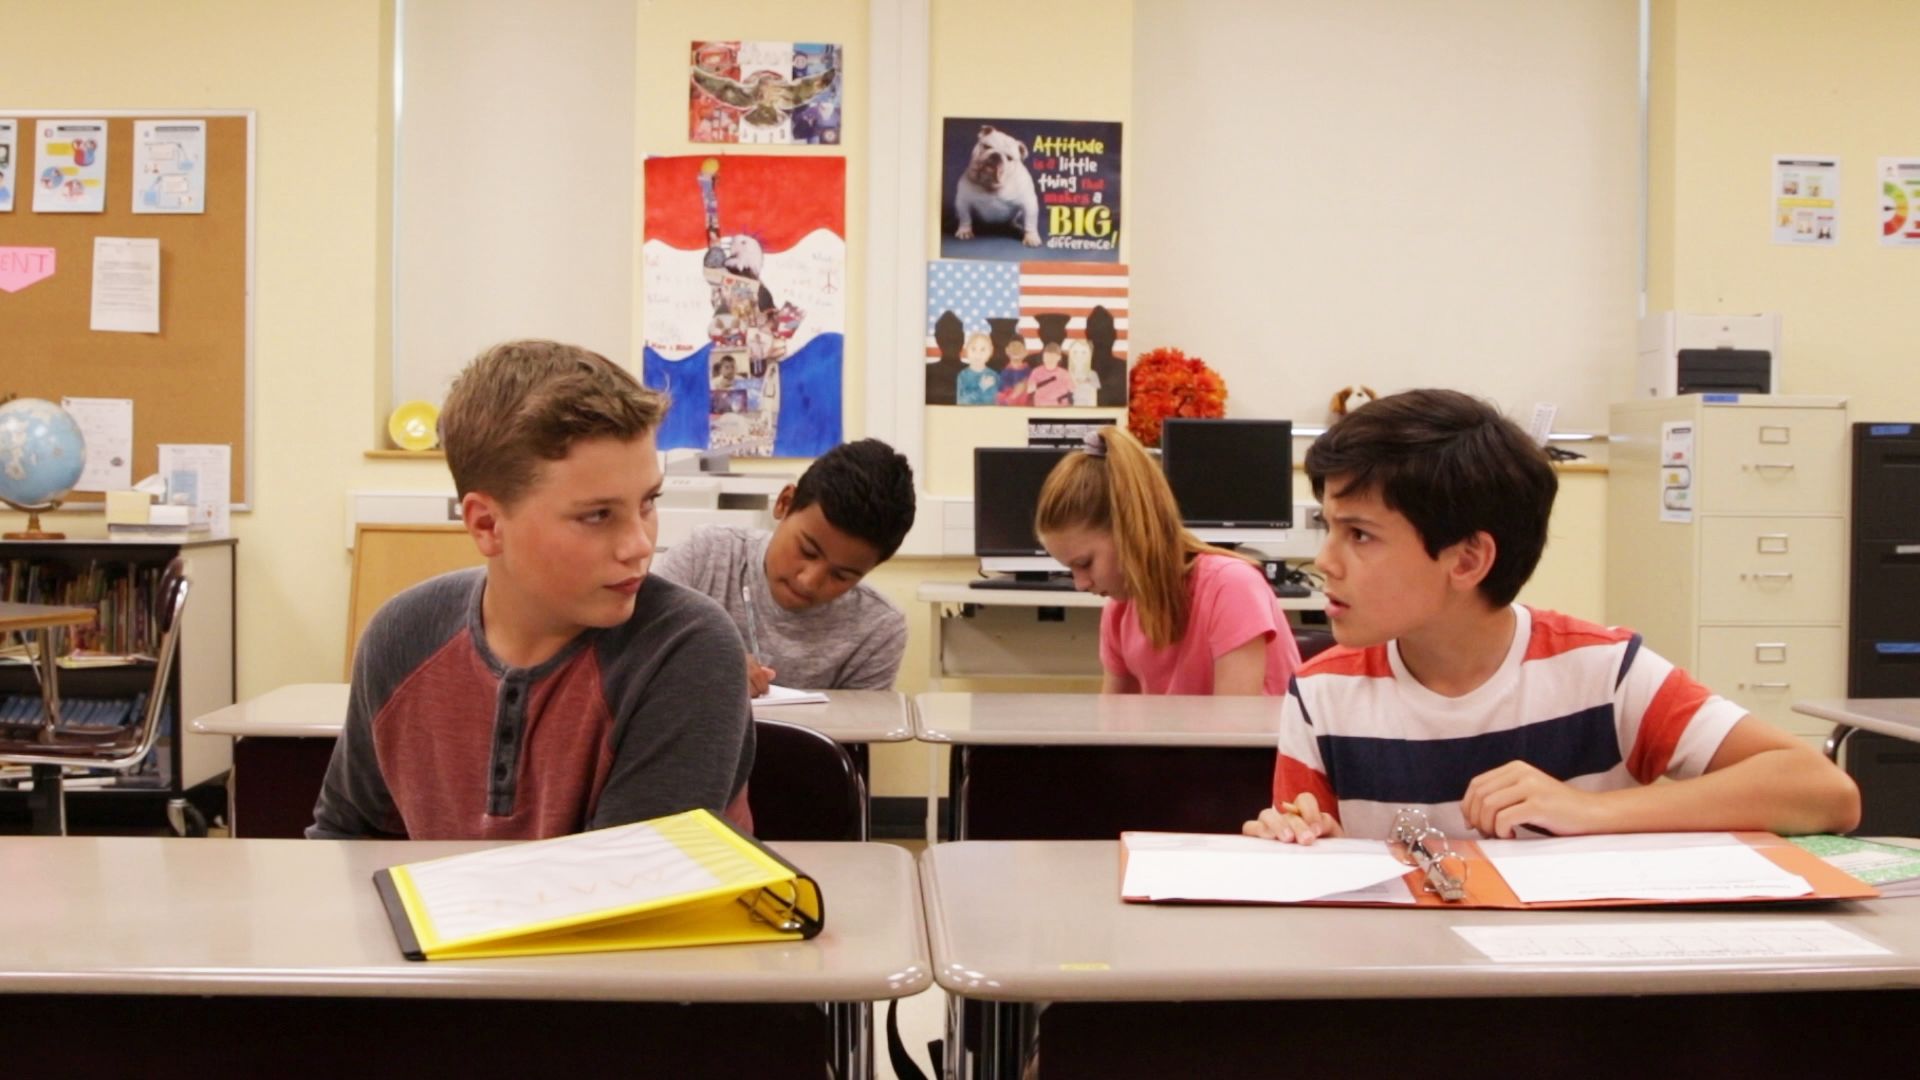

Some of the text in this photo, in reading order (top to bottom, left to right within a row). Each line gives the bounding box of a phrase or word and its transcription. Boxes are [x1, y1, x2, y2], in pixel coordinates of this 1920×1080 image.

[1033, 135, 1104, 157] Attitude
[1058, 156, 1098, 176] little
[1038, 173, 1077, 193] thing
[1044, 190, 1103, 205] makes a
[1046, 205, 1112, 237] BIG
[1047, 231, 1118, 250] difference!
